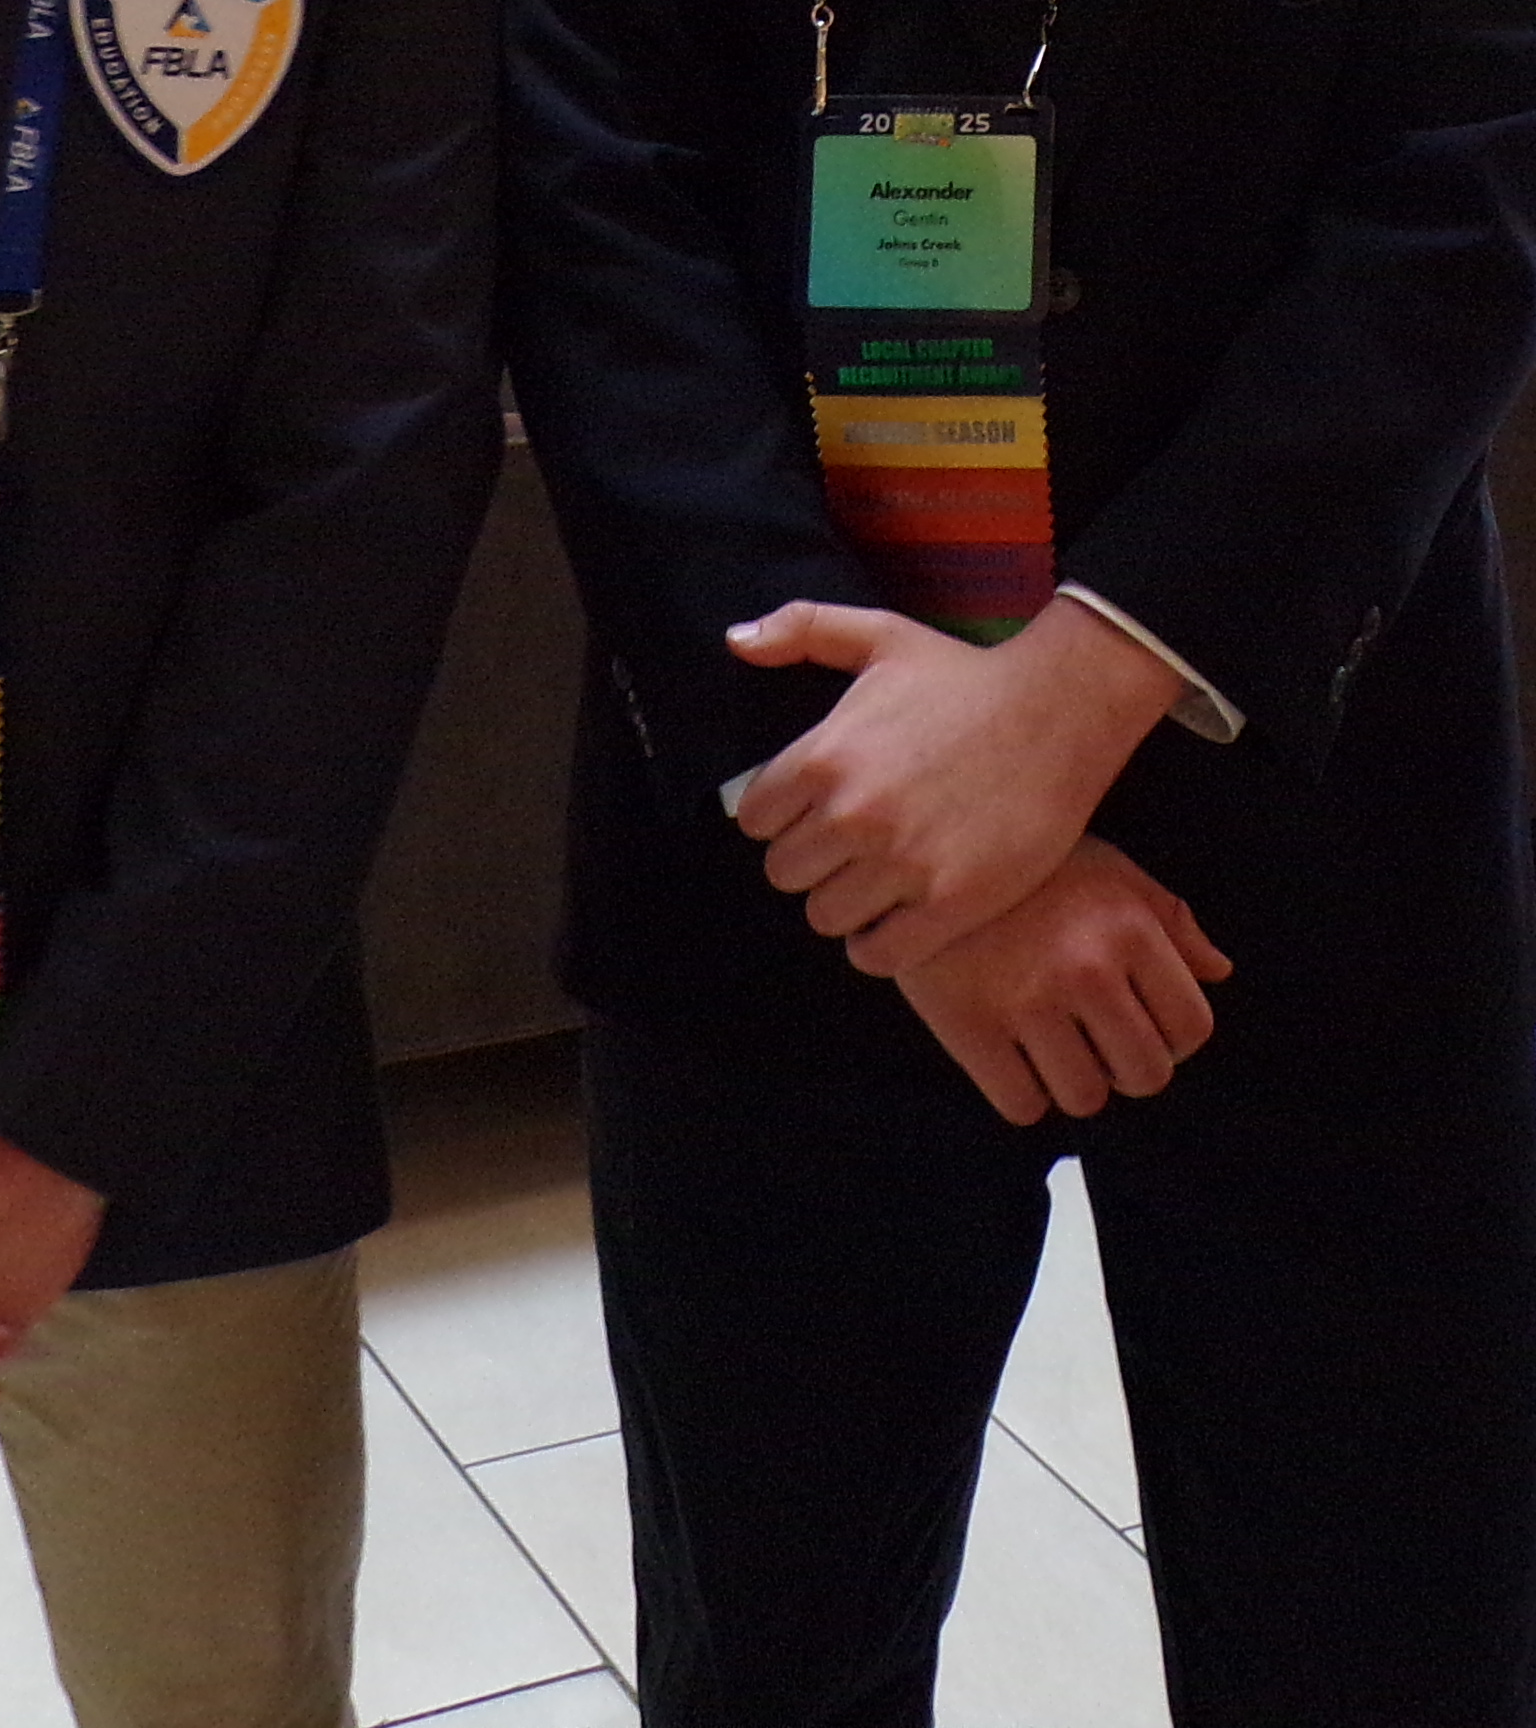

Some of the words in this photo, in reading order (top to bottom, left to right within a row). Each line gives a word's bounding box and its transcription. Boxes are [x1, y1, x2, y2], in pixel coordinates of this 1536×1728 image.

[90, 17, 167, 136] EDUCATION
[140, 45, 231, 80] FBLA
[859, 113, 891, 133] 20
[959, 113, 991, 133] 25
[5, 123, 42, 193] FBLA
[869, 181, 975, 201] Alexander
